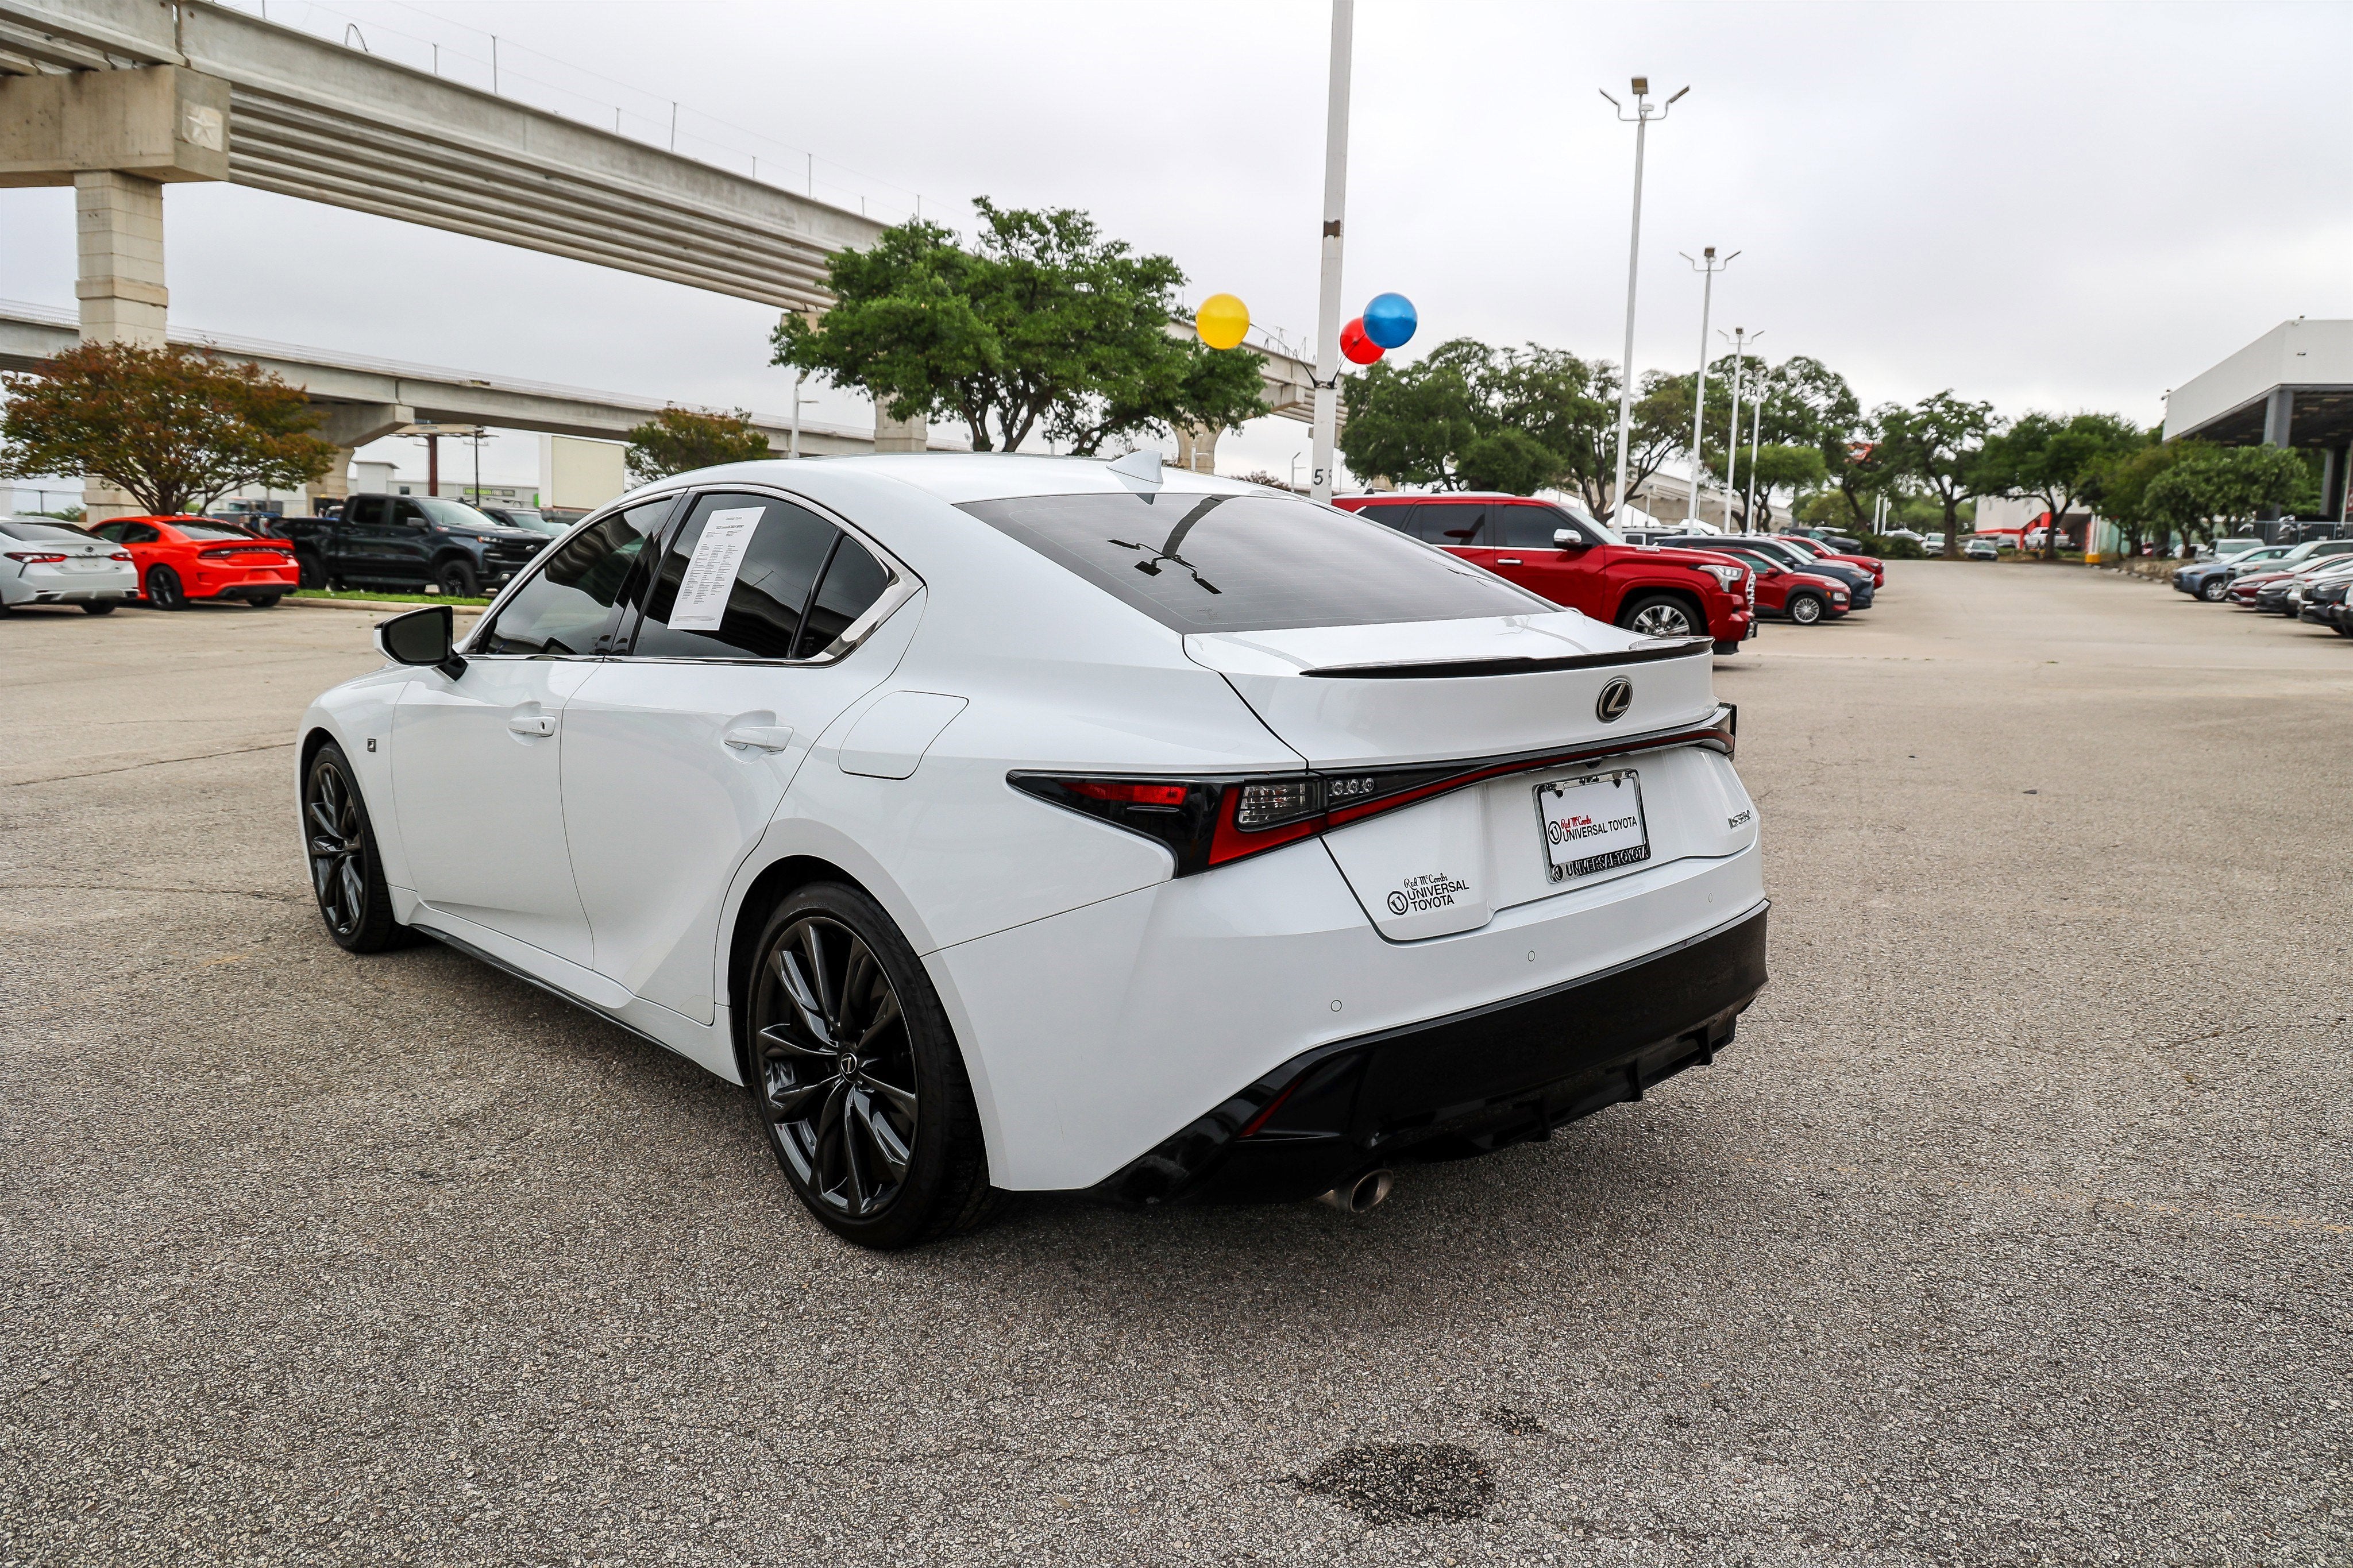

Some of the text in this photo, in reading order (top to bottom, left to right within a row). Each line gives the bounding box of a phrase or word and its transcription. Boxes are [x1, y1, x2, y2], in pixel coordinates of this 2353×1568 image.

[1313, 468, 1324, 485] 5
[1563, 816, 1638, 842] UNIVERSAL TOYOTA
[1565, 845, 1649, 876] UNIVERSAL TOYOTA
[1403, 872, 1448, 891] Red McCombs
[1406, 879, 1470, 901] UNIVERSAL
[1410, 894, 1455, 912] TOYOTA
